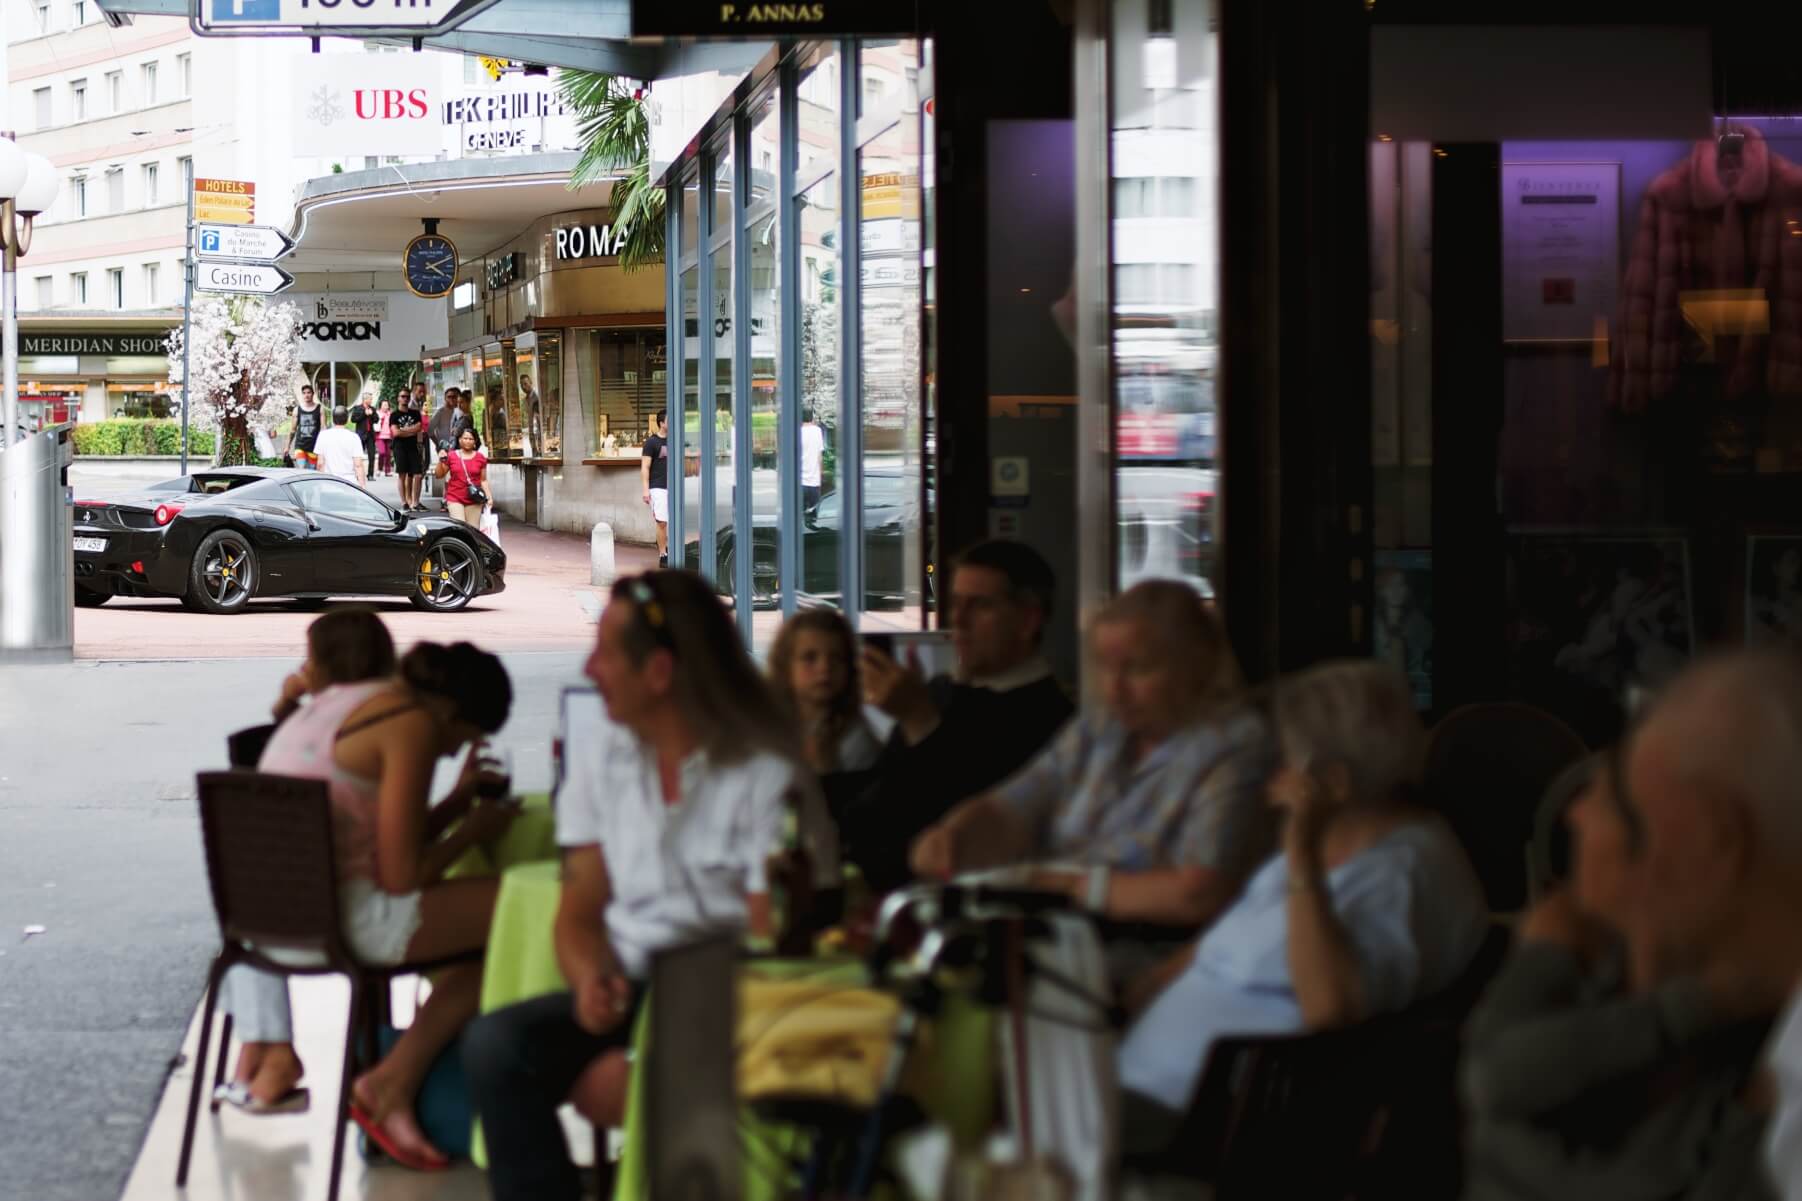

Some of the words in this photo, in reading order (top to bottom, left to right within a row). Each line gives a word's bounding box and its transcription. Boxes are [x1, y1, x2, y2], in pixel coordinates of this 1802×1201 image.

[721, 5, 740, 21] P.
[747, 4, 824, 21] ANNAS
[353, 88, 428, 119] UBS
[487, 91, 577, 121] PHILIPP
[205, 179, 246, 193] HOTELS
[556, 224, 631, 260] ROMA
[24, 337, 114, 353] MERIDIAN
